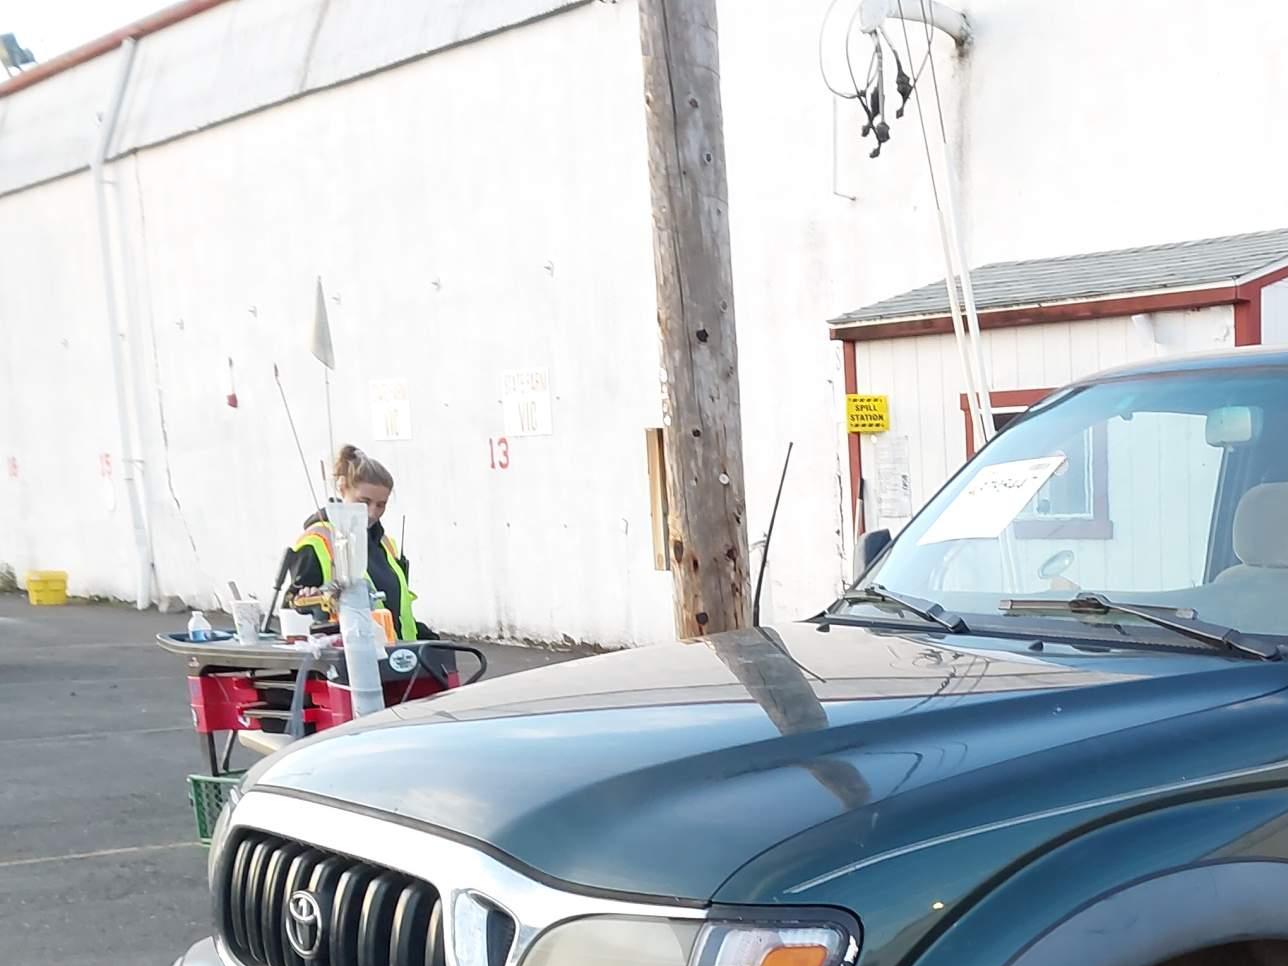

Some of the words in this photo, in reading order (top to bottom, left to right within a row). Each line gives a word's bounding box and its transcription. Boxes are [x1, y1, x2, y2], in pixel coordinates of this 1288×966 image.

[855, 403, 878, 412] SPILL
[850, 413, 885, 423] STATION
[488, 436, 510, 470] 13
